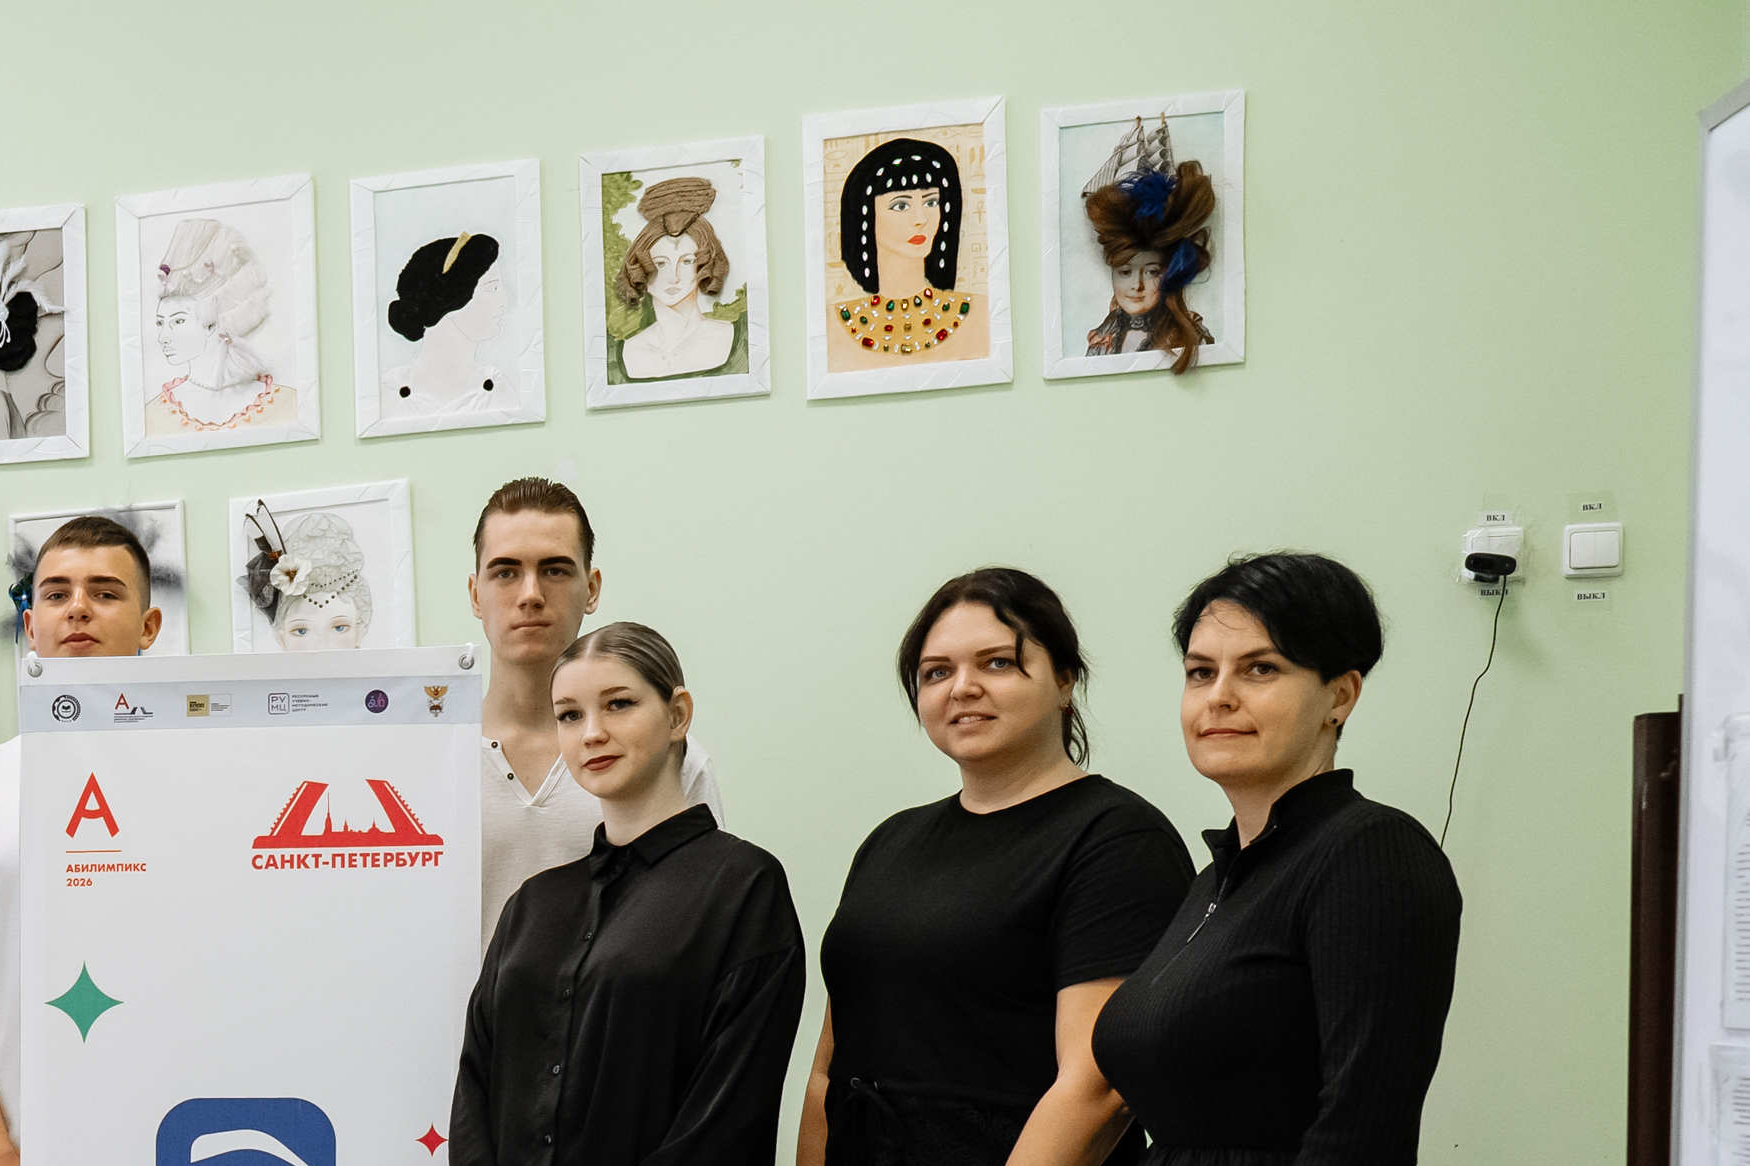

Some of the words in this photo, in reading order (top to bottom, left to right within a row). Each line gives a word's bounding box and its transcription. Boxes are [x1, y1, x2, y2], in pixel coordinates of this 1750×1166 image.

[1582, 503, 1602, 511] ВКЛ
[1486, 514, 1506, 522] ВКЛ
[1576, 592, 1606, 601] ВЫКЛ
[271, 704, 287, 712] МЦ
[251, 851, 445, 871] САНКТ-ПЕТЕРБУРГ
[65, 862, 147, 874] АБИЛИМПИКС
[65, 877, 93, 887] 2026
